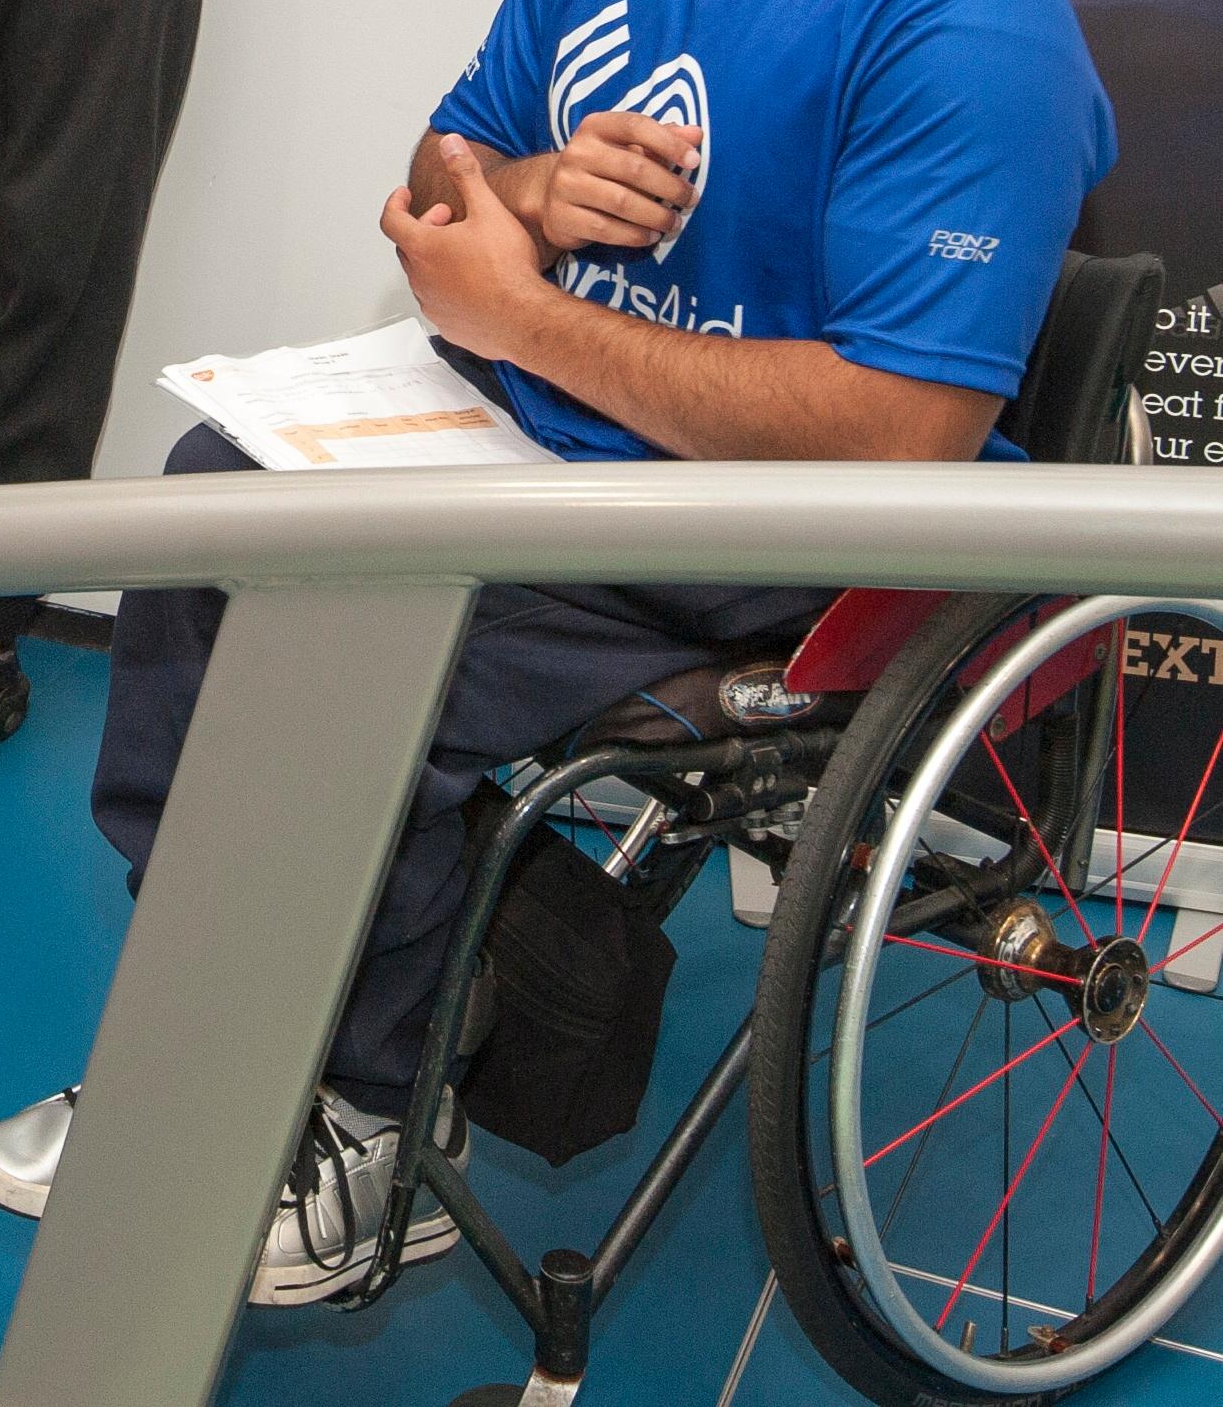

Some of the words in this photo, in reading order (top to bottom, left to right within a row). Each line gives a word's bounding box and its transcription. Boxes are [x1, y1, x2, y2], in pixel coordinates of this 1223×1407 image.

[928, 242, 994, 264] TOON
[1186, 304, 1211, 333] it
[1142, 390, 1203, 419] eat
[1153, 436, 1193, 460] ur
[1203, 441, 1223, 463] e
